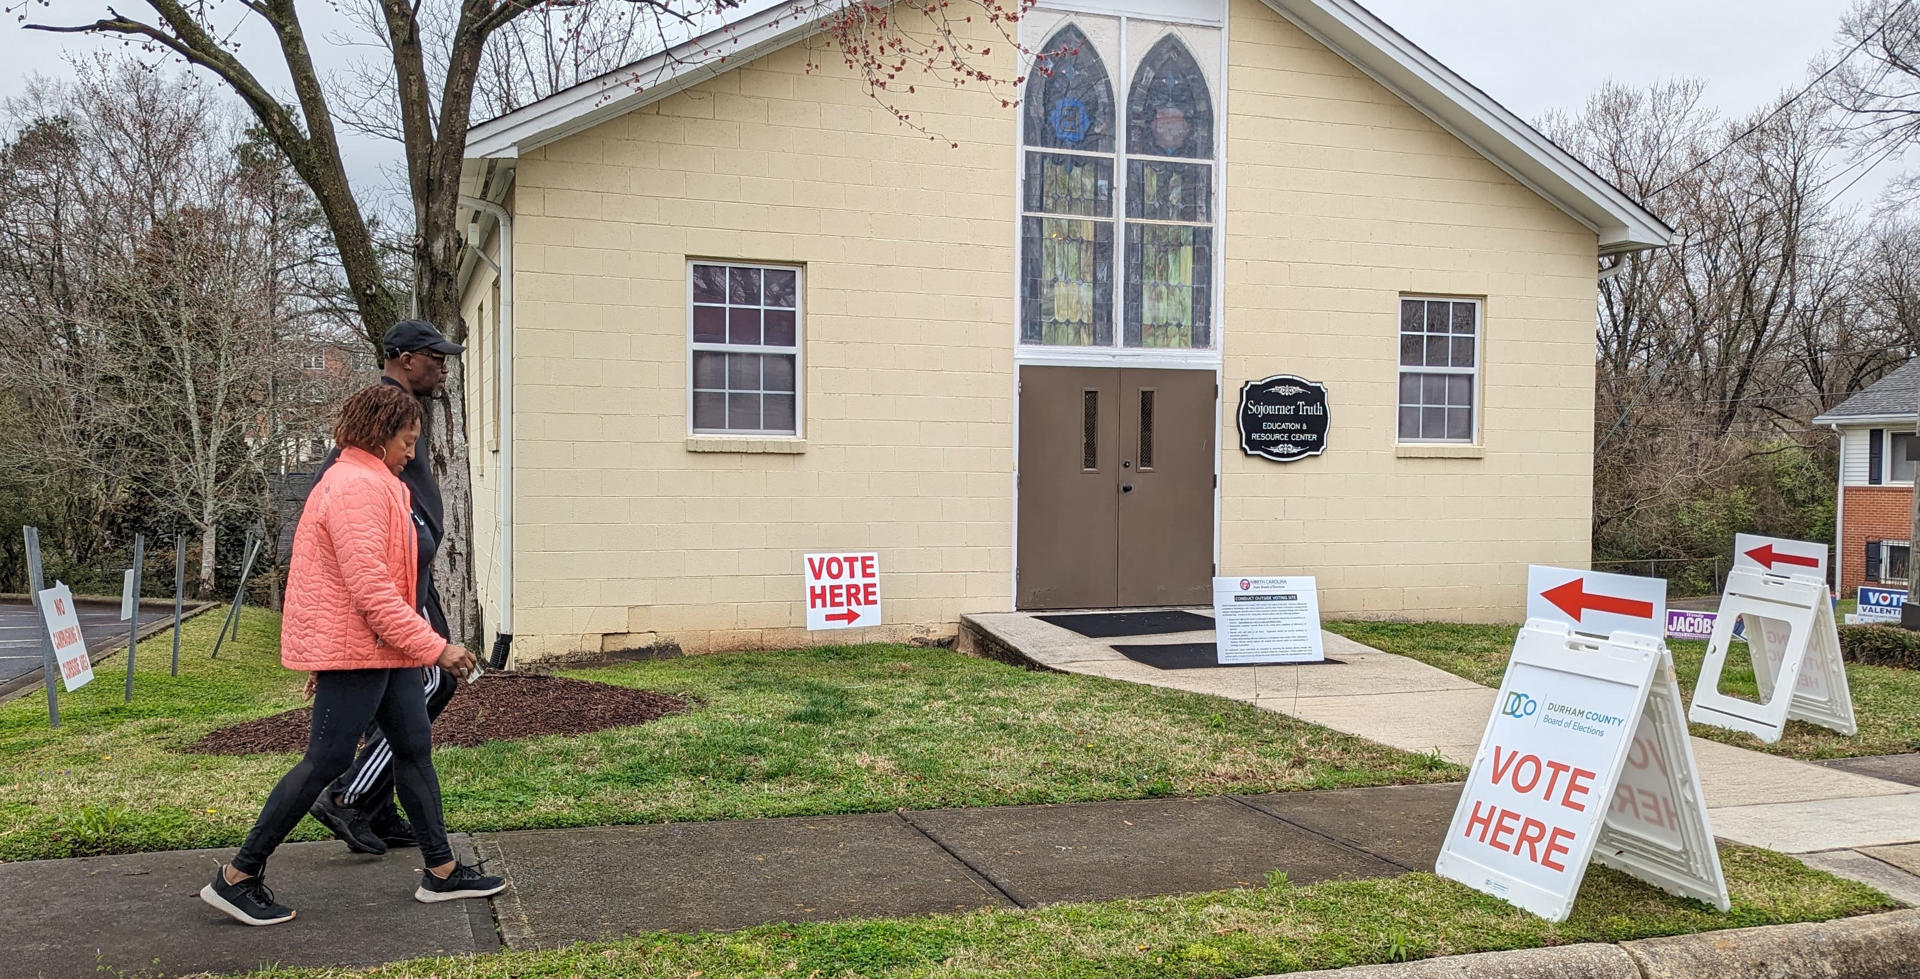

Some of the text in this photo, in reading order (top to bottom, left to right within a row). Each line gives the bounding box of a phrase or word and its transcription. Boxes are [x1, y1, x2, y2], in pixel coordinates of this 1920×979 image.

[1247, 400, 1323, 418] Sojourner Truth
[1251, 433, 1317, 441] RESOURCE CENTER
[1262, 422, 1301, 430] EDUCATION
[807, 556, 876, 581] VOTE
[54, 598, 65, 617] NO
[809, 583, 878, 609] HERE
[1861, 606, 1901, 615] VALENTI
[1543, 714, 1604, 737] Board of Elections
[1547, 702, 1624, 727] DURHAM COUNTY
[1490, 745, 1596, 812] VOTE
[1464, 800, 1576, 873] HERE
